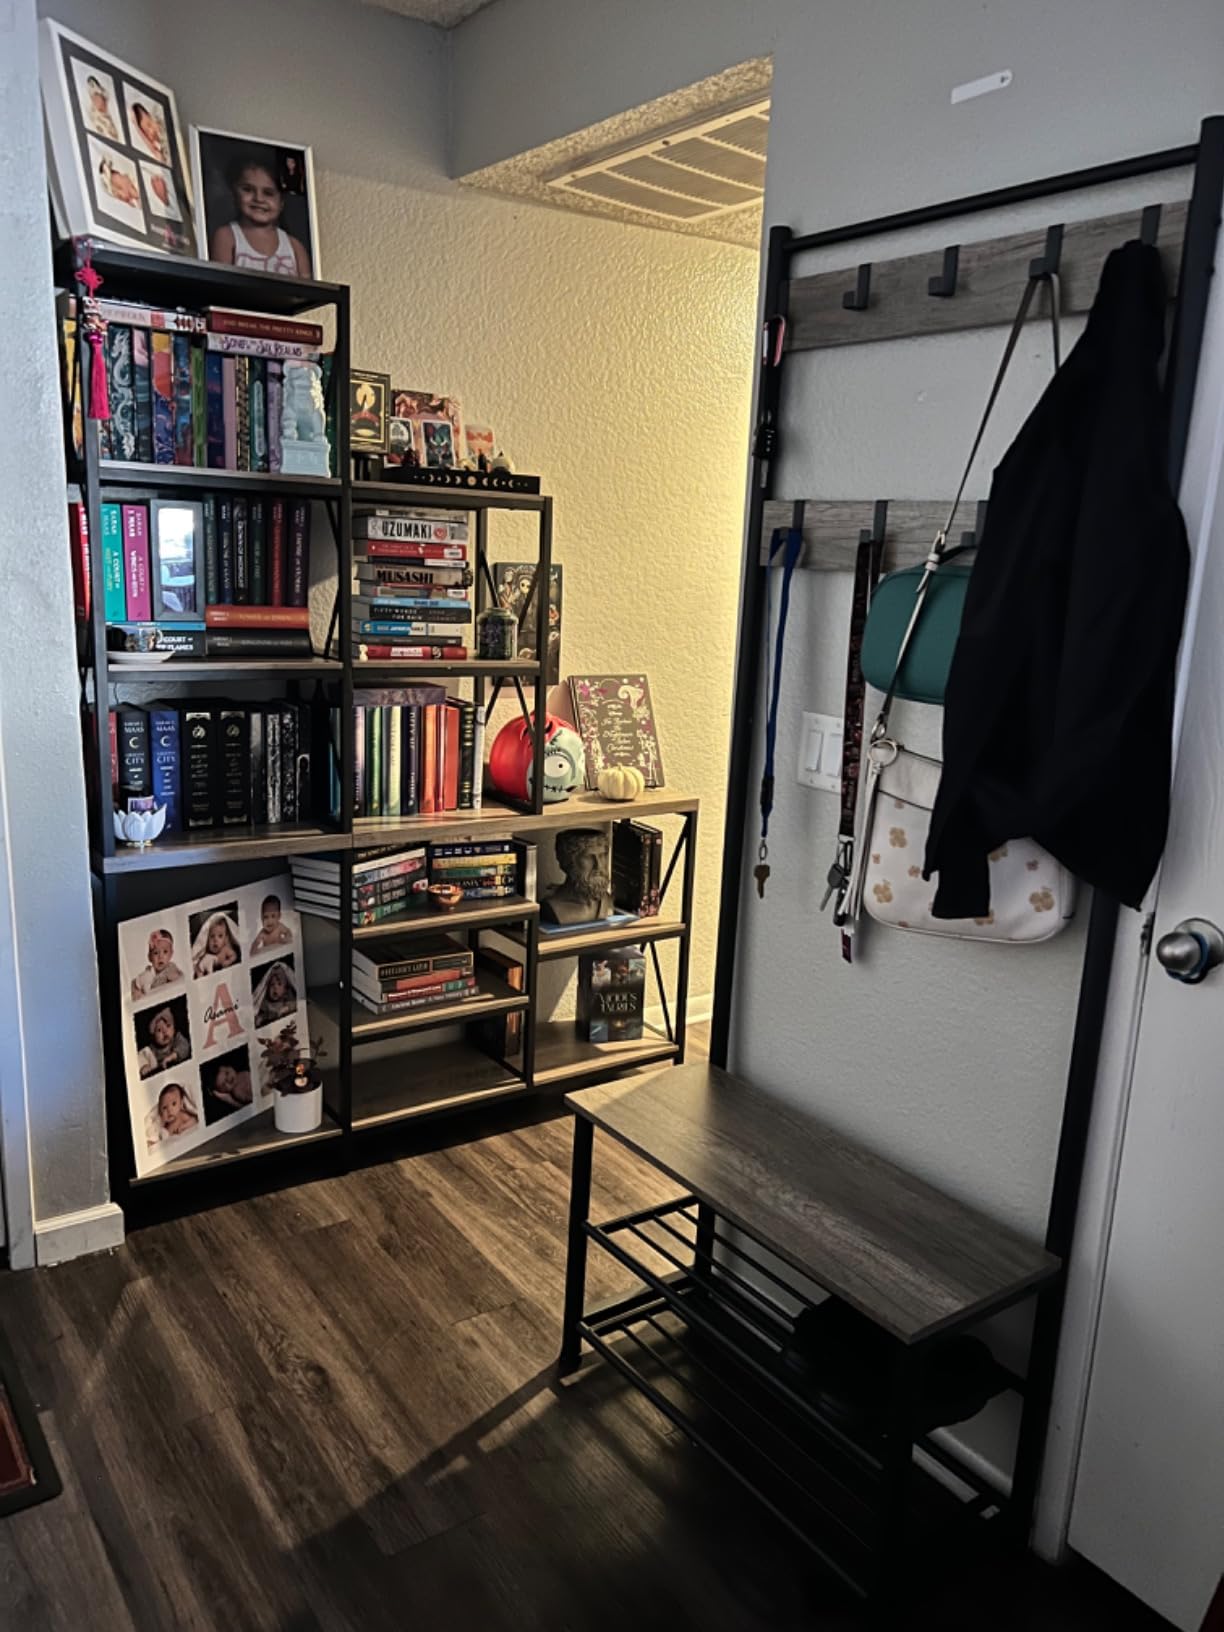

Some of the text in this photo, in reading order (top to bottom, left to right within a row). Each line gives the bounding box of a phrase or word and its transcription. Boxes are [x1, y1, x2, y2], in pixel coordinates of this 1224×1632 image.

[382, 521, 432, 539] UZUMAKI
[377, 569, 434, 585] MUSASHI
[203, 982, 246, 1050] A
